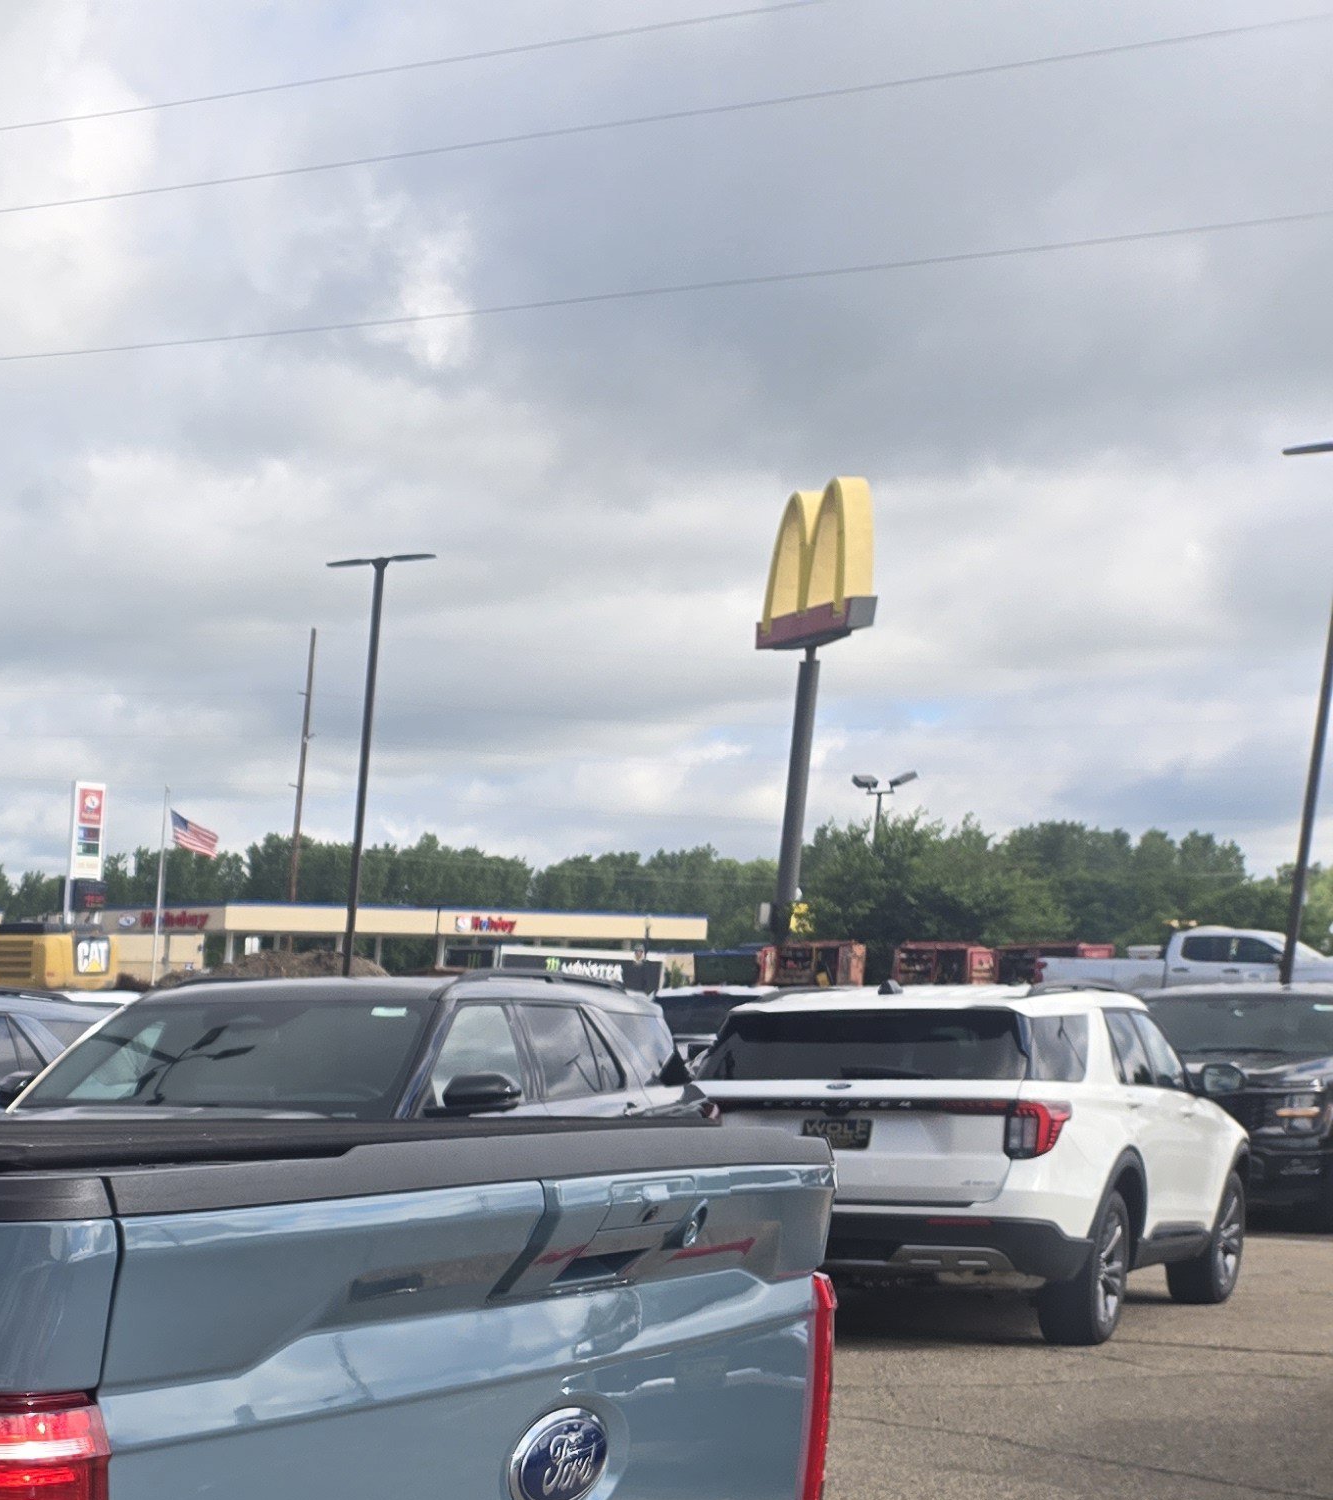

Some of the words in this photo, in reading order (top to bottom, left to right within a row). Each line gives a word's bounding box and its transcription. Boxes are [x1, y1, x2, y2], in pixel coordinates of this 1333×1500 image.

[77, 941, 108, 973] CAT
[805, 1119, 871, 1135] WOLF
[542, 1430, 598, 1497] Ford
